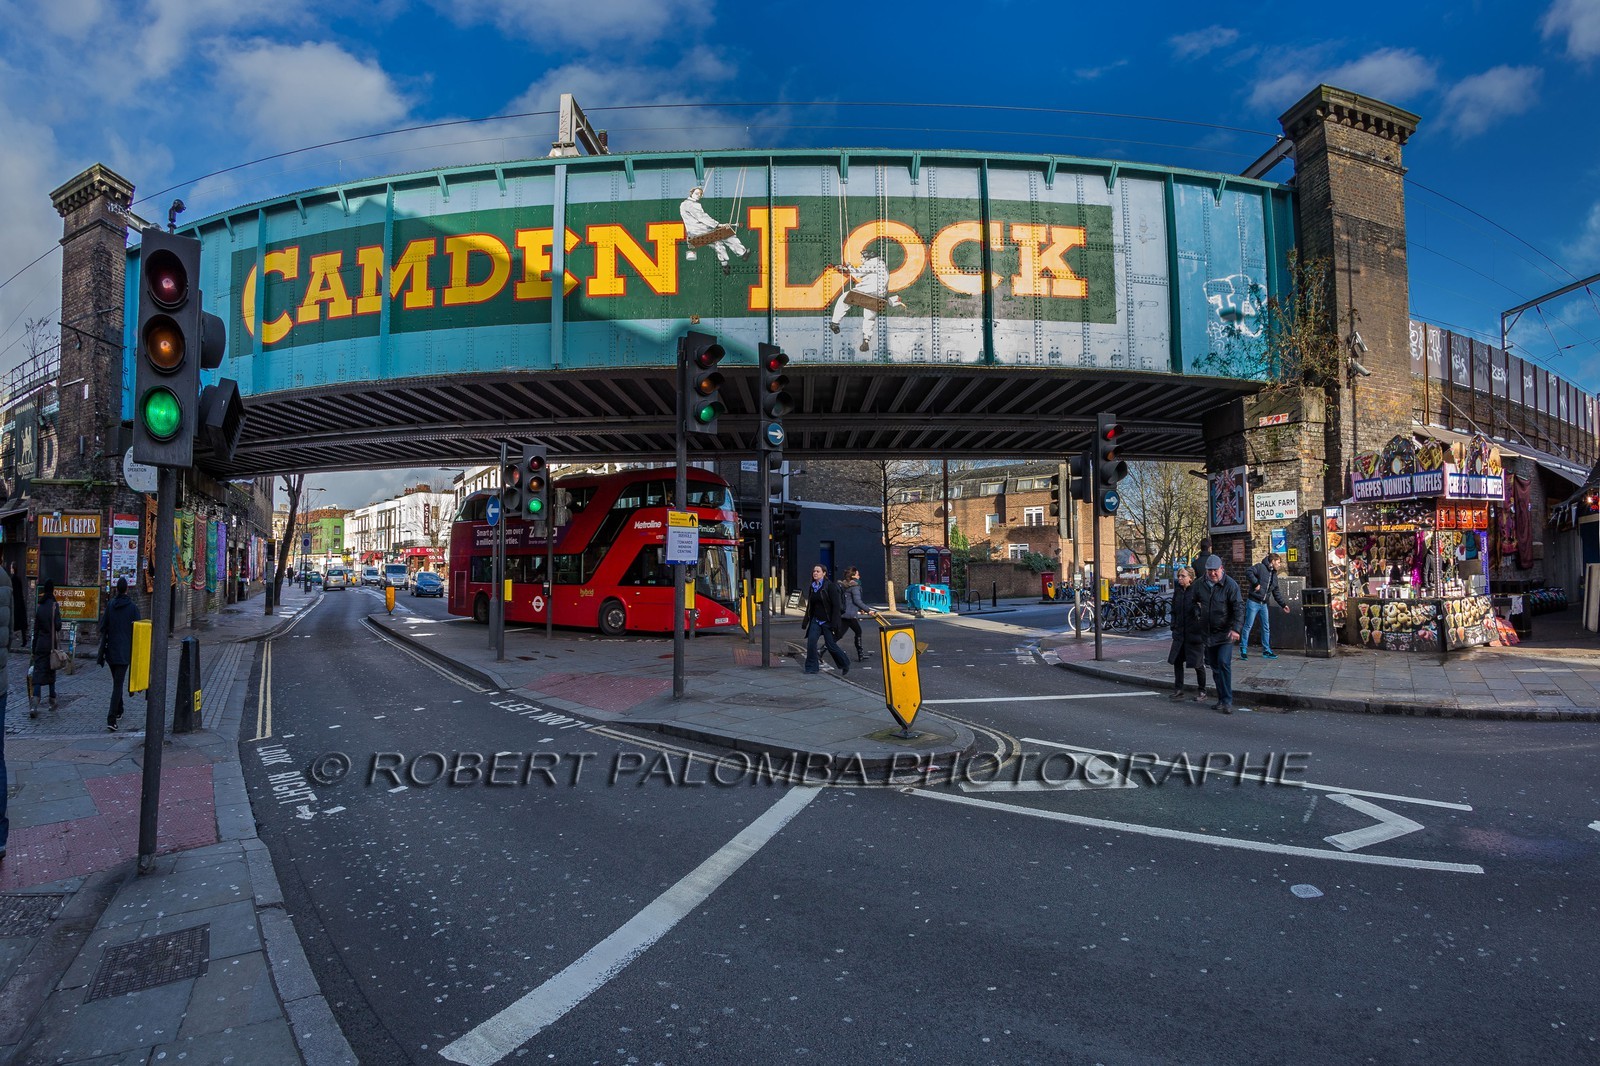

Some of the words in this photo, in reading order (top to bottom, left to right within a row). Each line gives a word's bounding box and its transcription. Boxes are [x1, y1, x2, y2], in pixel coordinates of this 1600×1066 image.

[242, 221, 686, 345] CAMDEN
[747, 205, 1088, 311] LOCK
[1355, 481, 1382, 498] CREPES
[1384, 477, 1411, 496] DONUTS
[1414, 472, 1442, 492] WAFFLES
[1450, 476, 1468, 493] CREPES
[1440, 508, 1450, 522] £1
[42, 516, 62, 532] PIZZA
[70, 516, 96, 534] CREPES
[634, 520, 662, 529] Metroline
[490, 700, 542, 716] LEFT
[528, 712, 586, 730] LOOK
[256, 744, 294, 766] LOOK
[268, 770, 318, 804] RIGHT
